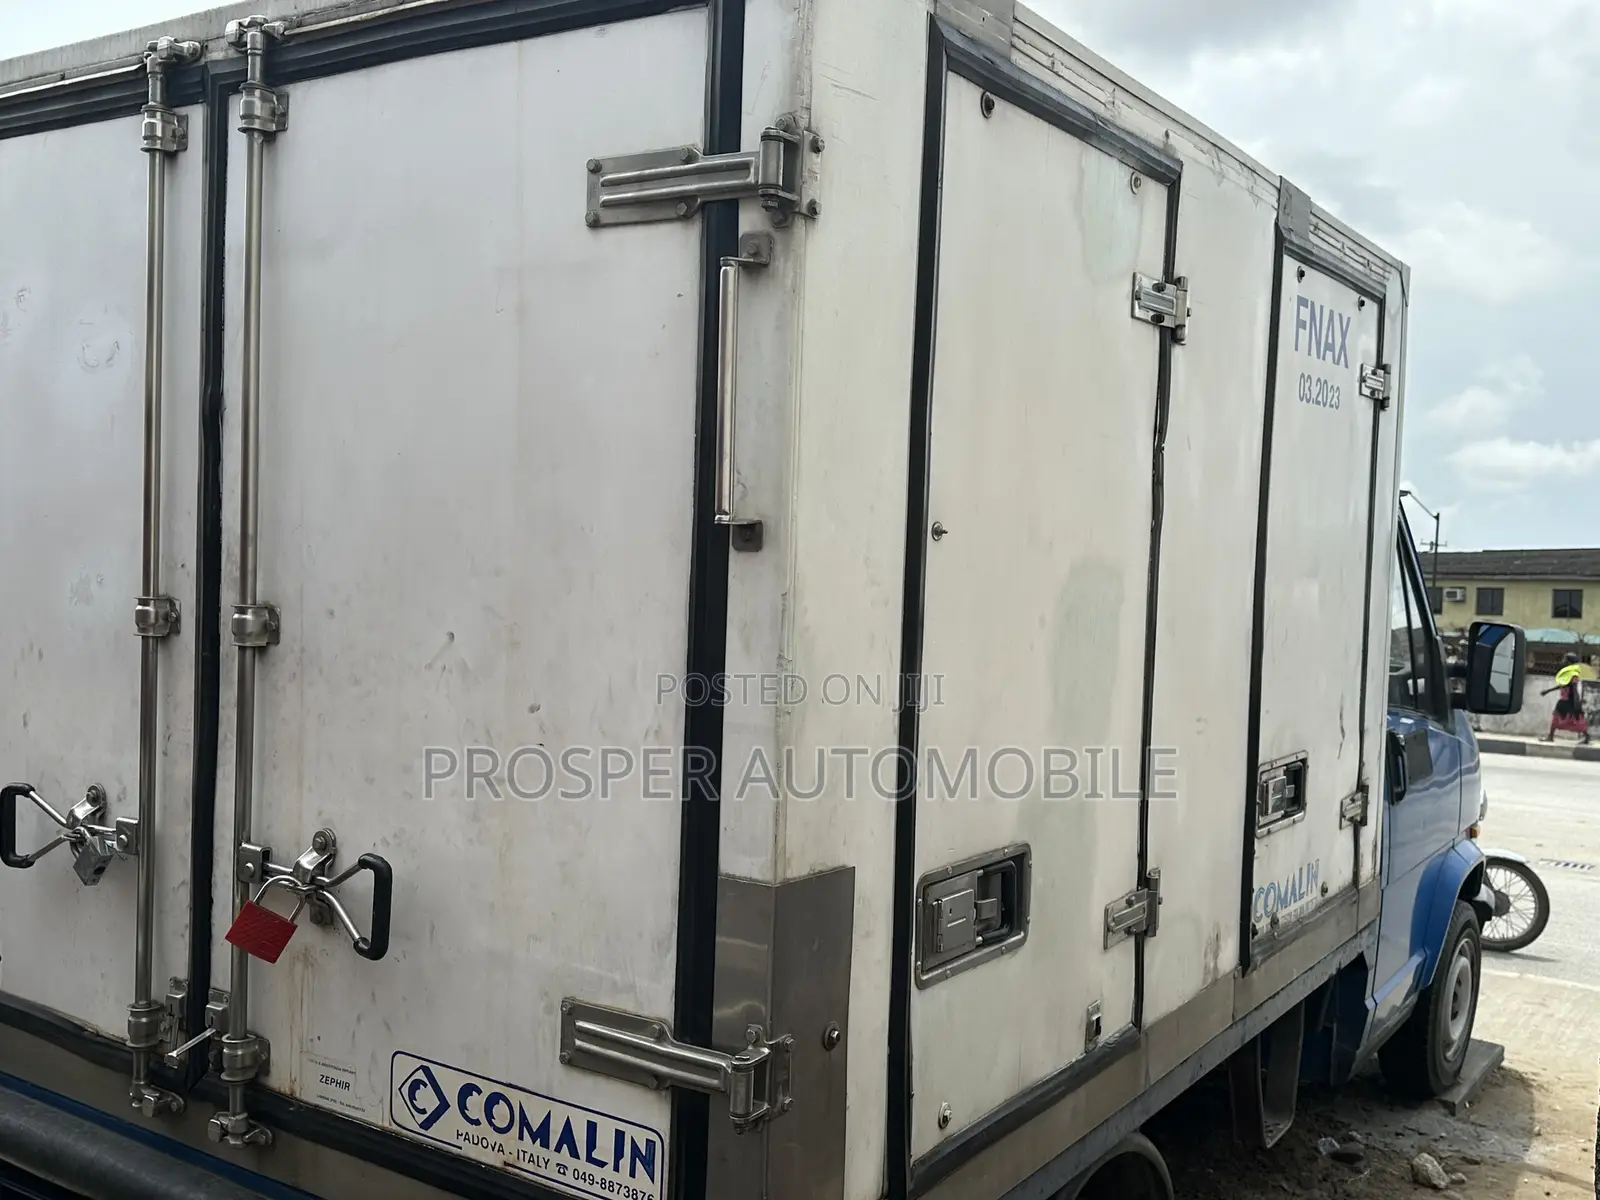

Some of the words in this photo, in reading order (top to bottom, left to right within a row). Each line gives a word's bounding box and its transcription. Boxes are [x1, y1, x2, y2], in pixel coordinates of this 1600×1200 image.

[1294, 294, 1351, 369] FNAX
[1298, 372, 1340, 410] 03.2023
[1253, 858, 1320, 923] COMALIN
[319, 1074, 351, 1091] ZEPHIR
[456, 1129, 505, 1156] PADOVA
[516, 1149, 550, 1170] ITALY
[457, 1082, 656, 1184] COMALIN
